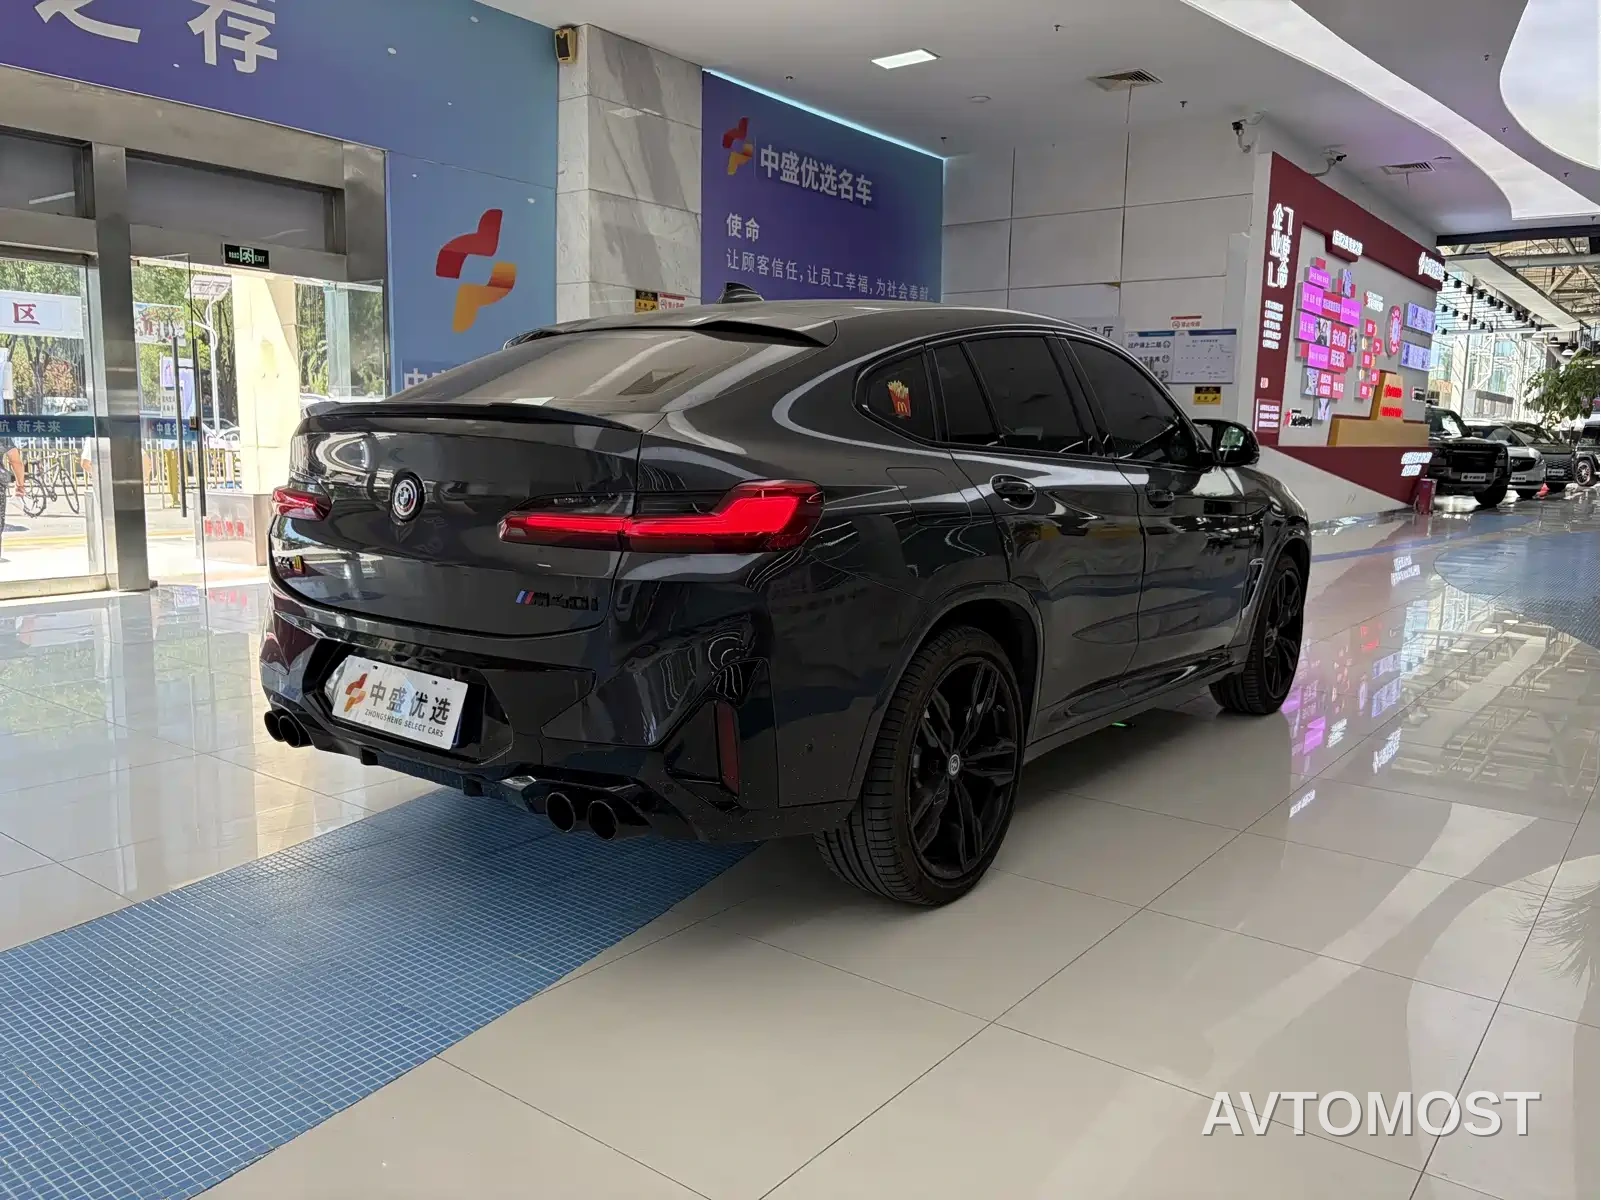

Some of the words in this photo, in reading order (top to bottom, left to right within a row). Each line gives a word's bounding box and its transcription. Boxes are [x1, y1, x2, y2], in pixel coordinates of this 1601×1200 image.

[760, 144, 873, 206] 中盛优选名车
[726, 212, 760, 242] 使命
[254, 254, 265, 263] EXIT
[13, 302, 40, 325] 区
[16, 419, 61, 433] 新未来
[369, 681, 451, 726] 中盛优选
[364, 708, 403, 726] ZHONGSHENG
[404, 720, 426, 733] SELECT
[427, 726, 444, 738] CARS
